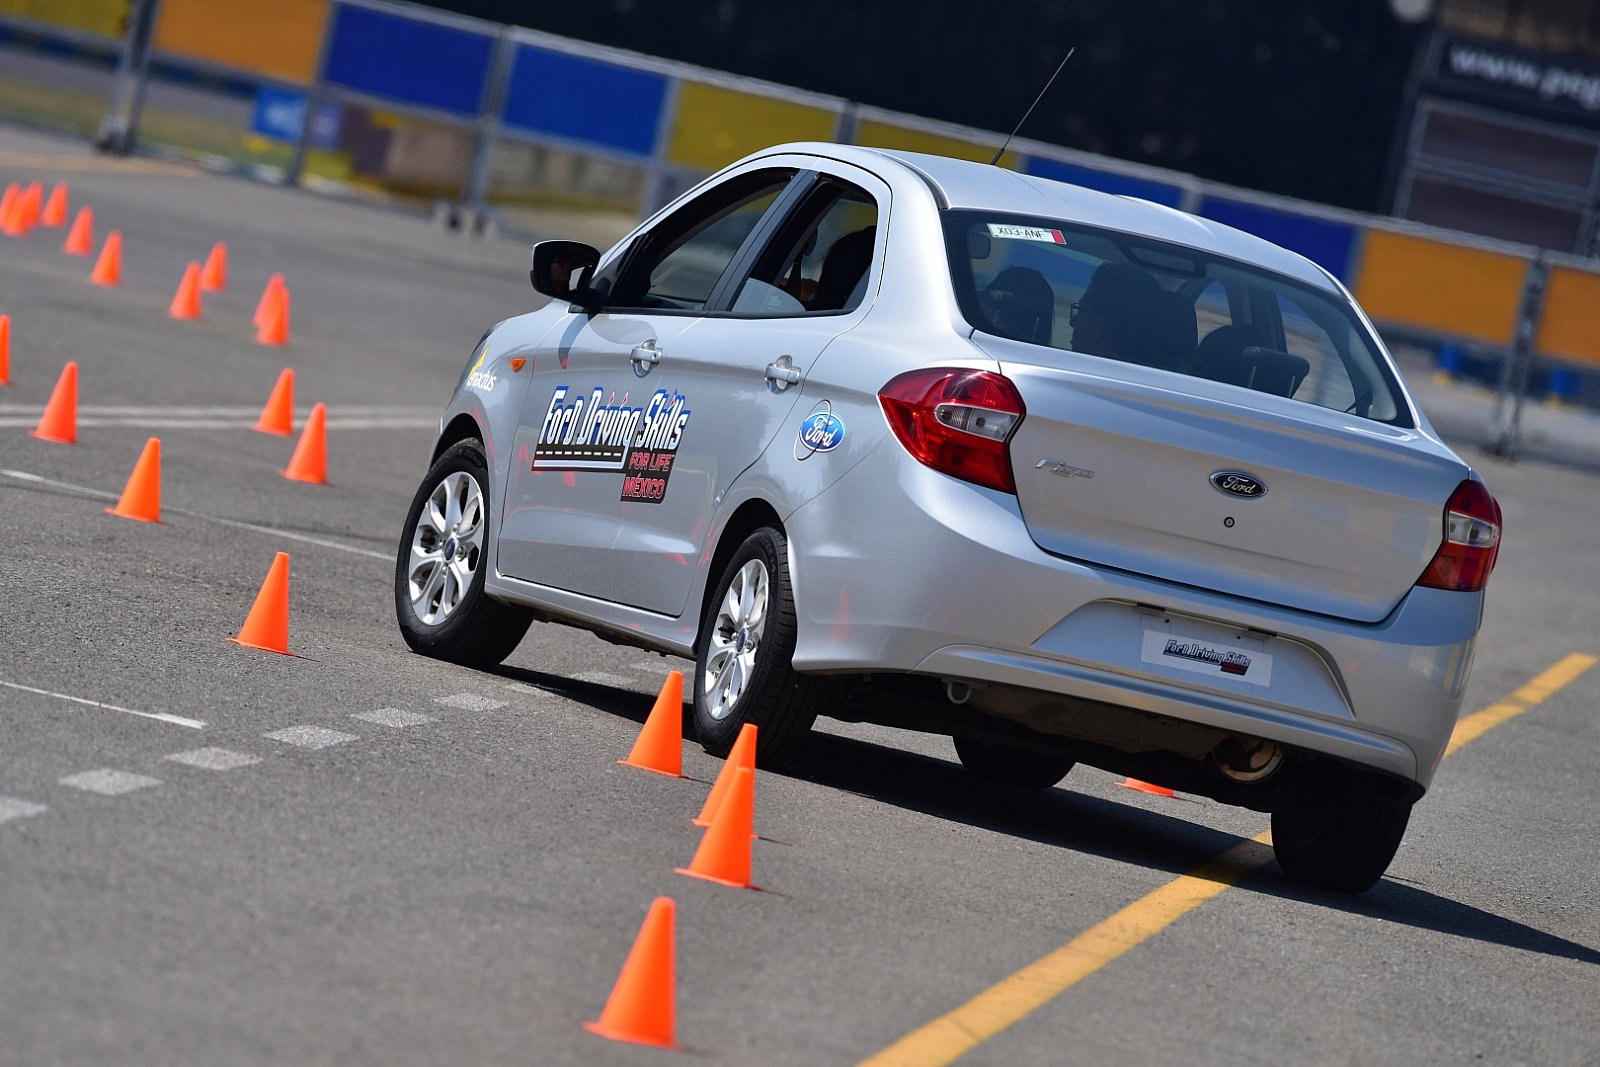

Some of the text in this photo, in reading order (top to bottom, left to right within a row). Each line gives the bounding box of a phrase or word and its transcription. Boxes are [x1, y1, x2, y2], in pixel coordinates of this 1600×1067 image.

[575, 387, 643, 450] Driving
[633, 389, 691, 451] Skills
[805, 415, 838, 447] Ford
[628, 452, 672, 472] FOR LIFE
[622, 473, 666, 499] MÉXICO
[1222, 475, 1256, 493] Ford
[1190, 644, 1226, 664] Driving
[1223, 651, 1251, 667] Skills
